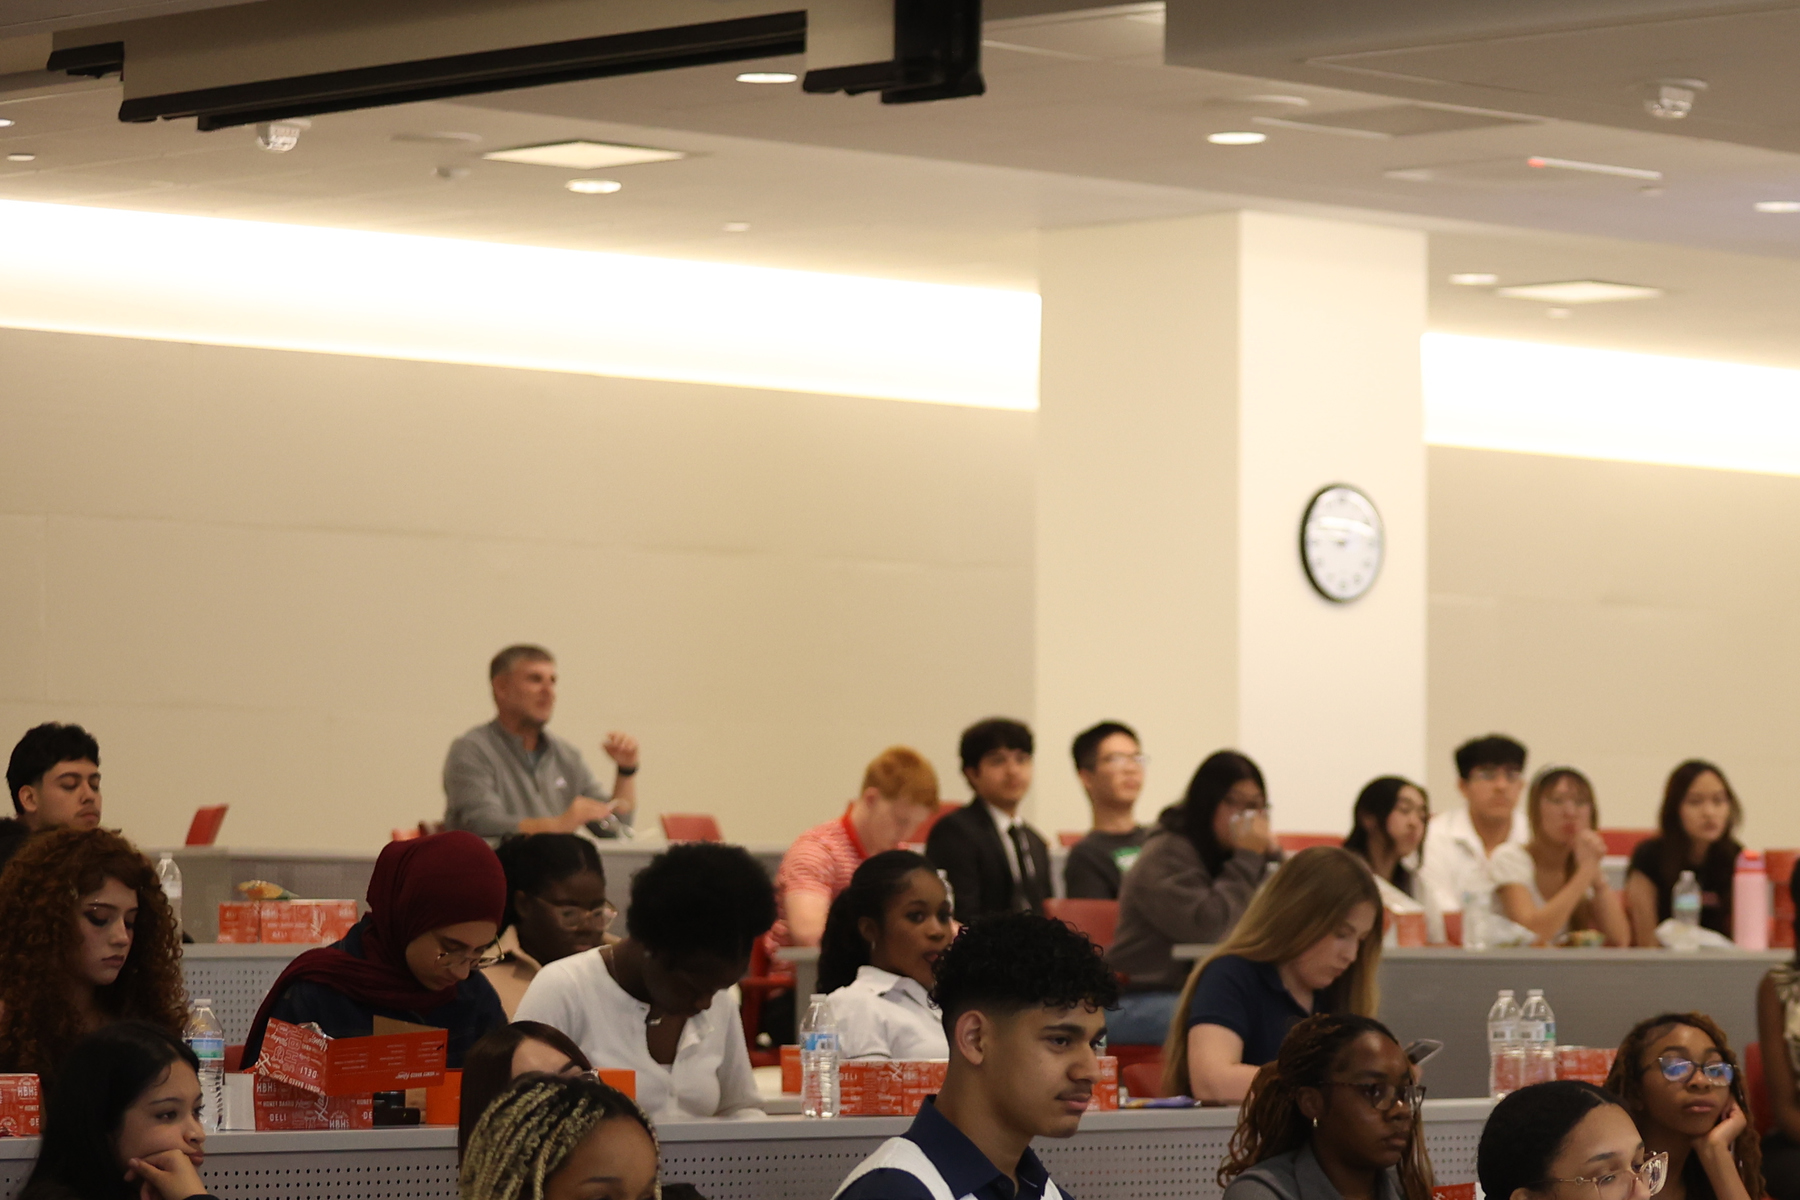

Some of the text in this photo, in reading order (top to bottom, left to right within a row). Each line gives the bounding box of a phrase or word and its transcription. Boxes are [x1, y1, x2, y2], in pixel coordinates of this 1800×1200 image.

[300, 1066, 318, 1079] DELI
[269, 1113, 287, 1122] DELI
[363, 1110, 373, 1119] DE
